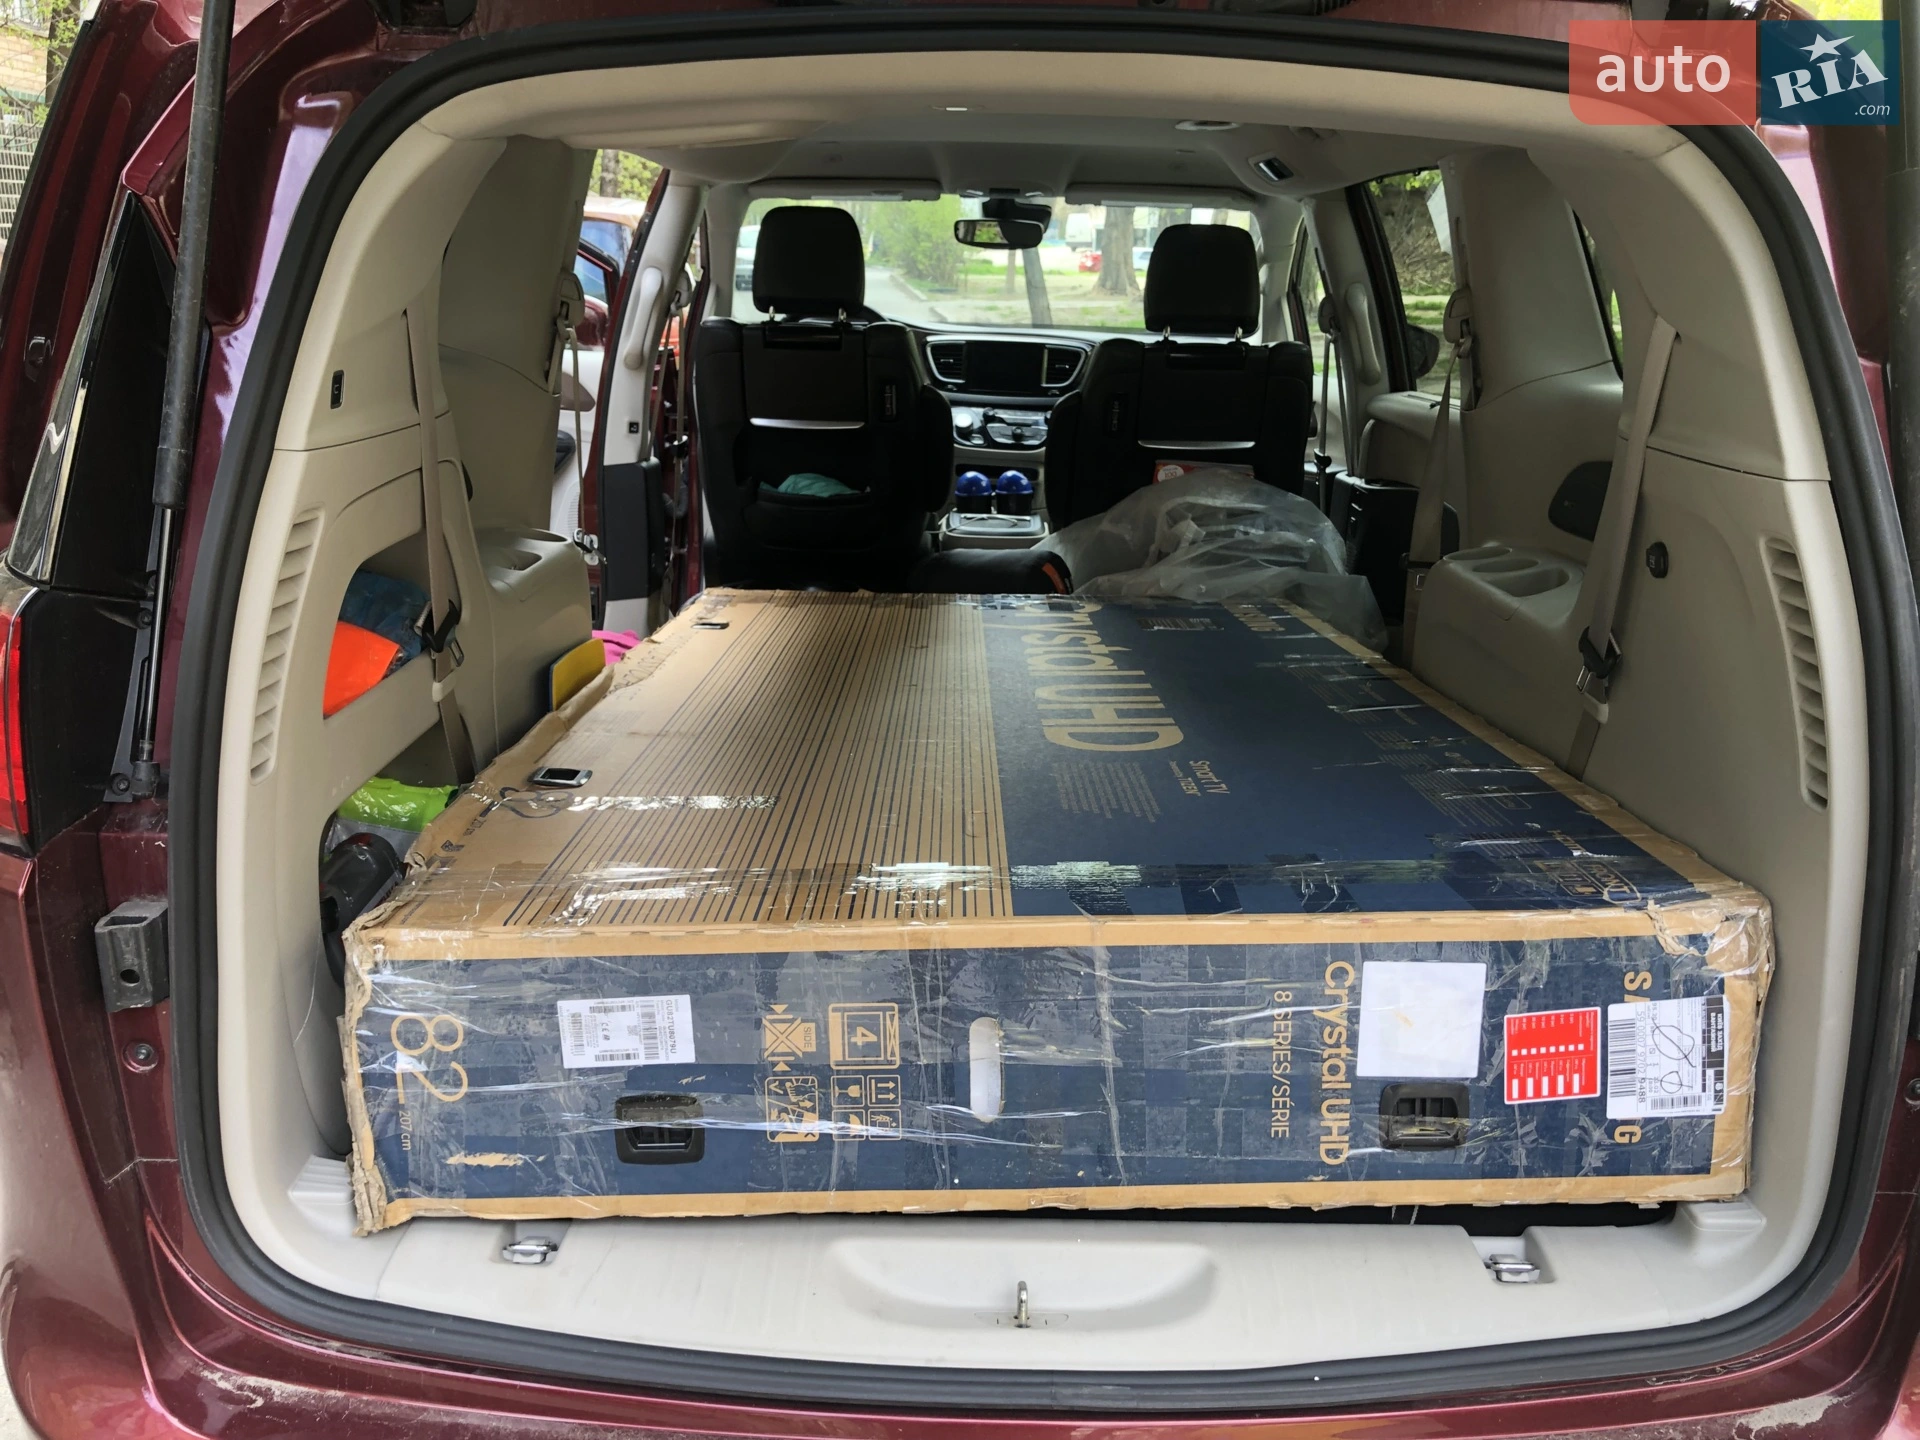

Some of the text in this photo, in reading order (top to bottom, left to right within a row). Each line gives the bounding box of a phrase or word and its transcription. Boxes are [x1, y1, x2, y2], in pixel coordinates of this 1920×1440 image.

[983, 600, 1146, 676] Crystal
[1034, 683, 1185, 752] UHD
[1189, 760, 1231, 795] Smart TV
[391, 1014, 468, 1104] 82
[666, 999, 677, 1054] GU82TU8079U
[803, 1027, 812, 1049] SIDE
[851, 1026, 877, 1046] 4
[1637, 1011, 1646, 1103] 59 0007 9702 9488
[1271, 990, 1293, 1138] 8 SERIES/SÉRIE
[1312, 960, 1356, 1166] Crystal UHD
[399, 1110, 413, 1151] 207 cm
